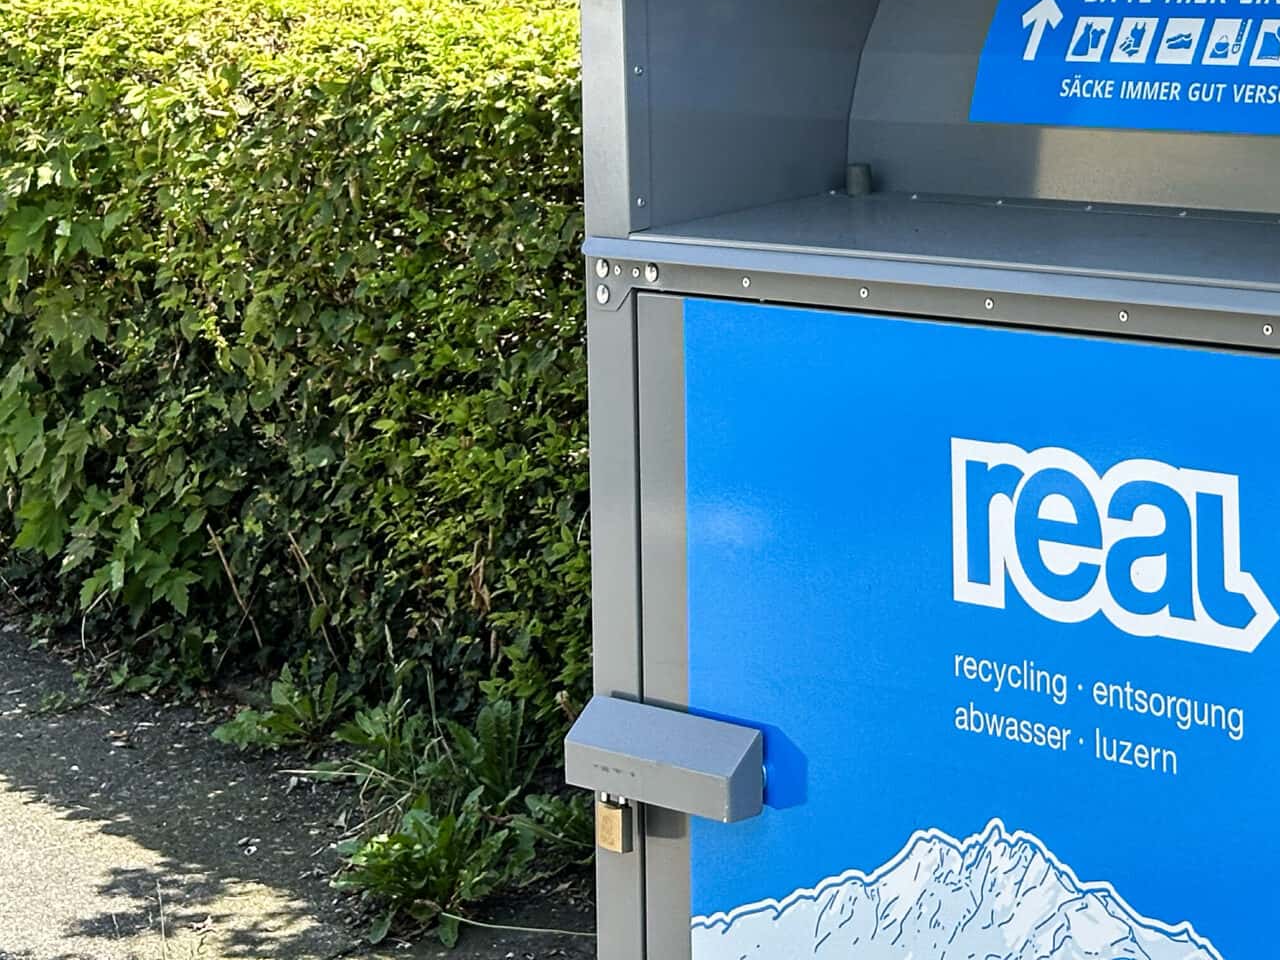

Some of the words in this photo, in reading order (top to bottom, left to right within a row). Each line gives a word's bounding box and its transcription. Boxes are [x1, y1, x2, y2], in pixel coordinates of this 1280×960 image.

[1058, 74, 1115, 100] SÄCKE
[1119, 80, 1181, 102] IMMER
[1187, 82, 1227, 104] GUT
[950, 437, 1280, 653] real
[954, 652, 1068, 705] recycling
[1092, 679, 1245, 741] entsorgung
[954, 701, 1071, 752] abwasser
[1094, 726, 1178, 775] luzern
